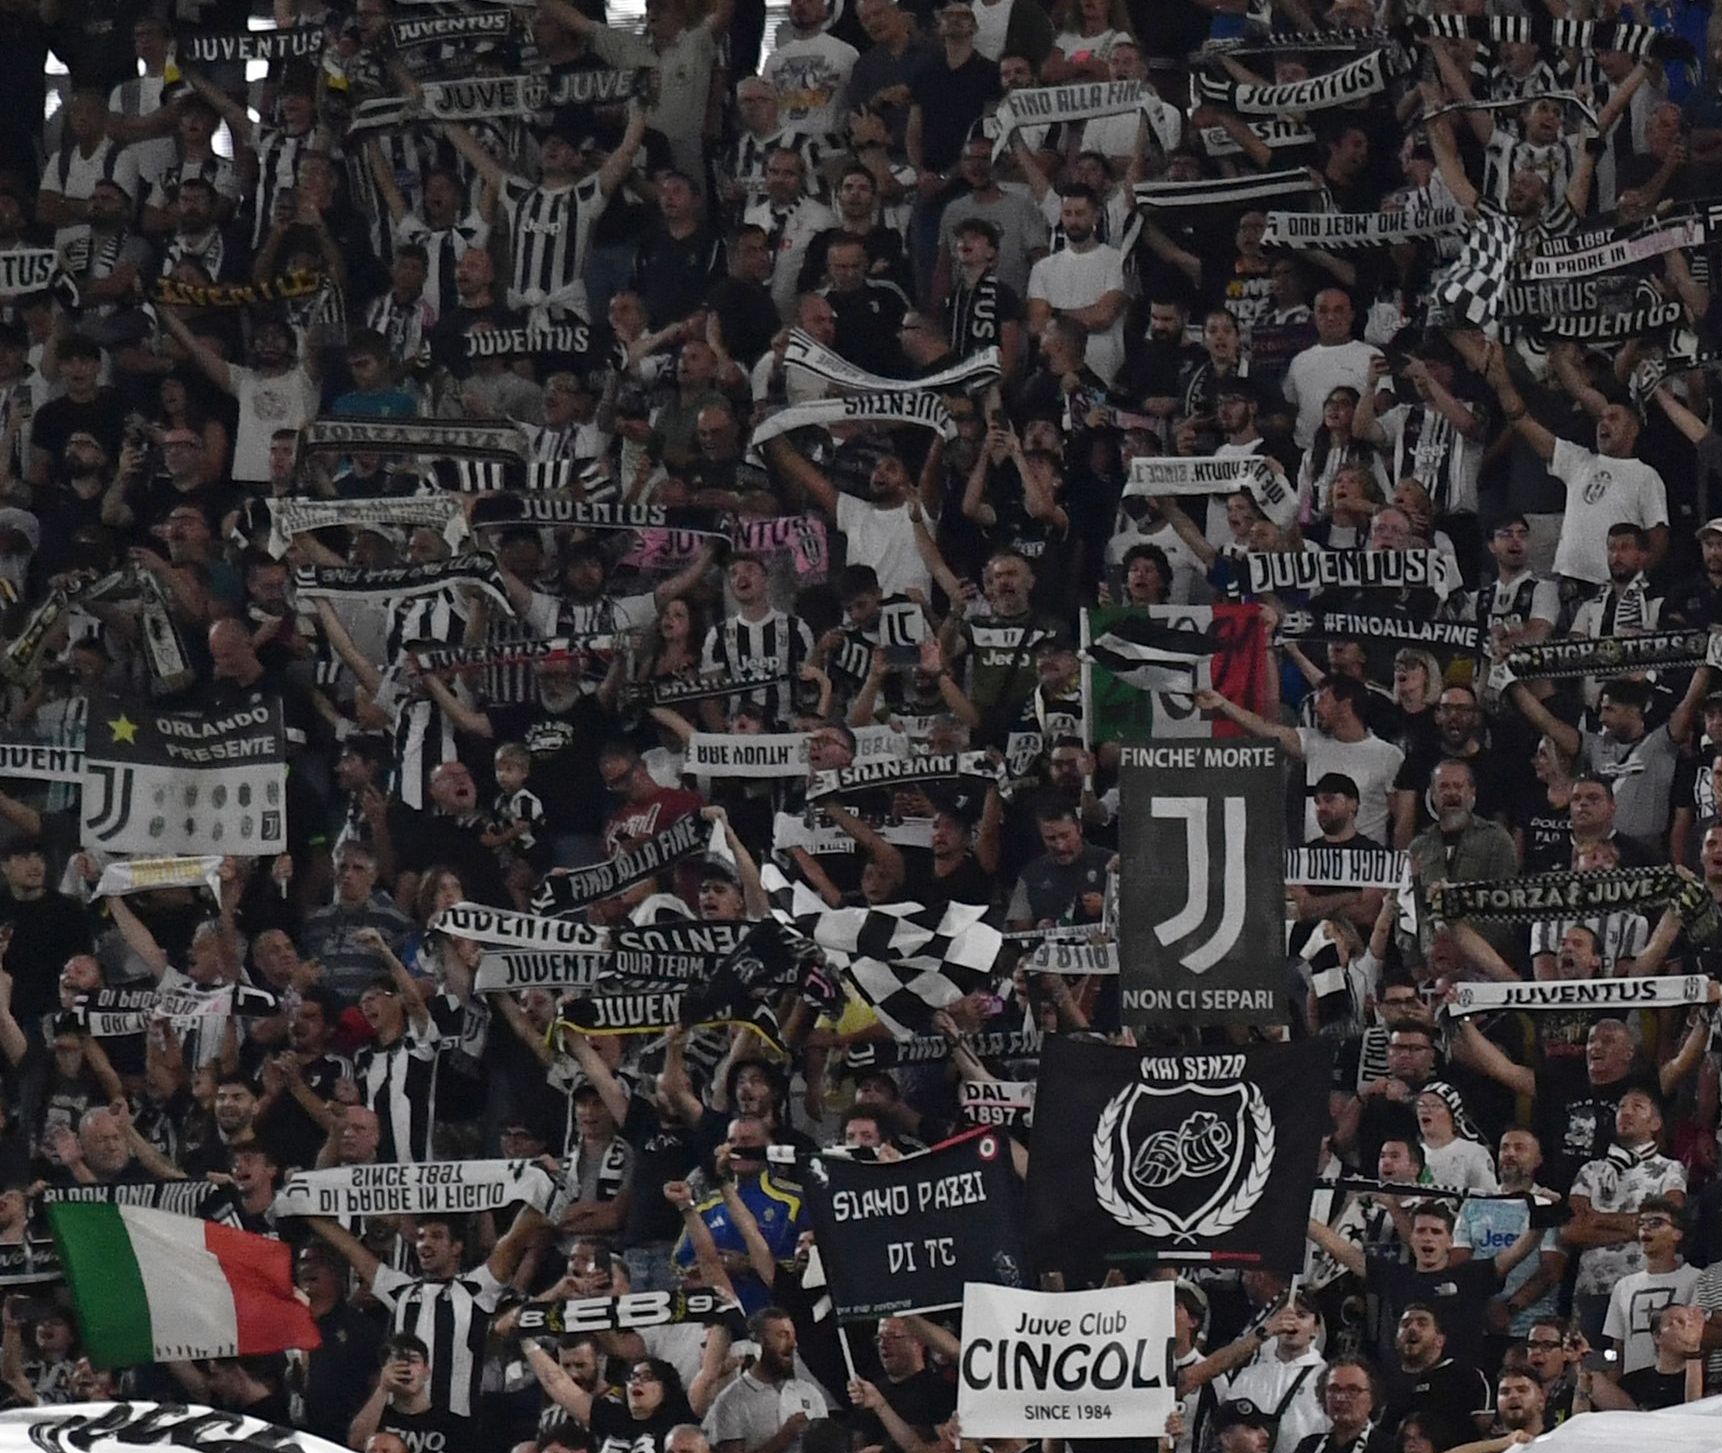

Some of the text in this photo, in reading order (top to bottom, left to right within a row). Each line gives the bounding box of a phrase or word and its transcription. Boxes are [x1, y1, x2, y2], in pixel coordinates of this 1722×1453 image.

[398, 11, 509, 40] JUVENTUS
[192, 31, 325, 62] JUVENTUS
[434, 70, 632, 113] JUVE JUVE
[1245, 55, 1378, 108] JUVENTUS
[520, 498, 667, 526] JUVENTUS
[1323, 611, 1480, 649] #FINOALLAFINE
[155, 706, 270, 740] ORLANDO
[165, 732, 278, 761] PRESENTE
[1120, 746, 1276, 770] FINCHE' MORTE
[1476, 878, 1657, 912] FORZA JUVE
[616, 951, 653, 979] OUR
[1122, 990, 1274, 1011] NON CI SEPARI
[1504, 979, 1659, 1006] JUVENTUS
[1140, 1053, 1248, 1081] MAI SENZA
[965, 1083, 1012, 1103] DAL
[964, 1106, 1016, 1129] 1897
[832, 1170, 987, 1223] SIAMO PAZZI
[1478, 1228, 1521, 1248] Jee
[886, 1242, 919, 1274] DI
[564, 1291, 673, 1333] EB
[1014, 1306, 1129, 1336] Juve Club
[1024, 1403, 1113, 1421] SINCE 1984
